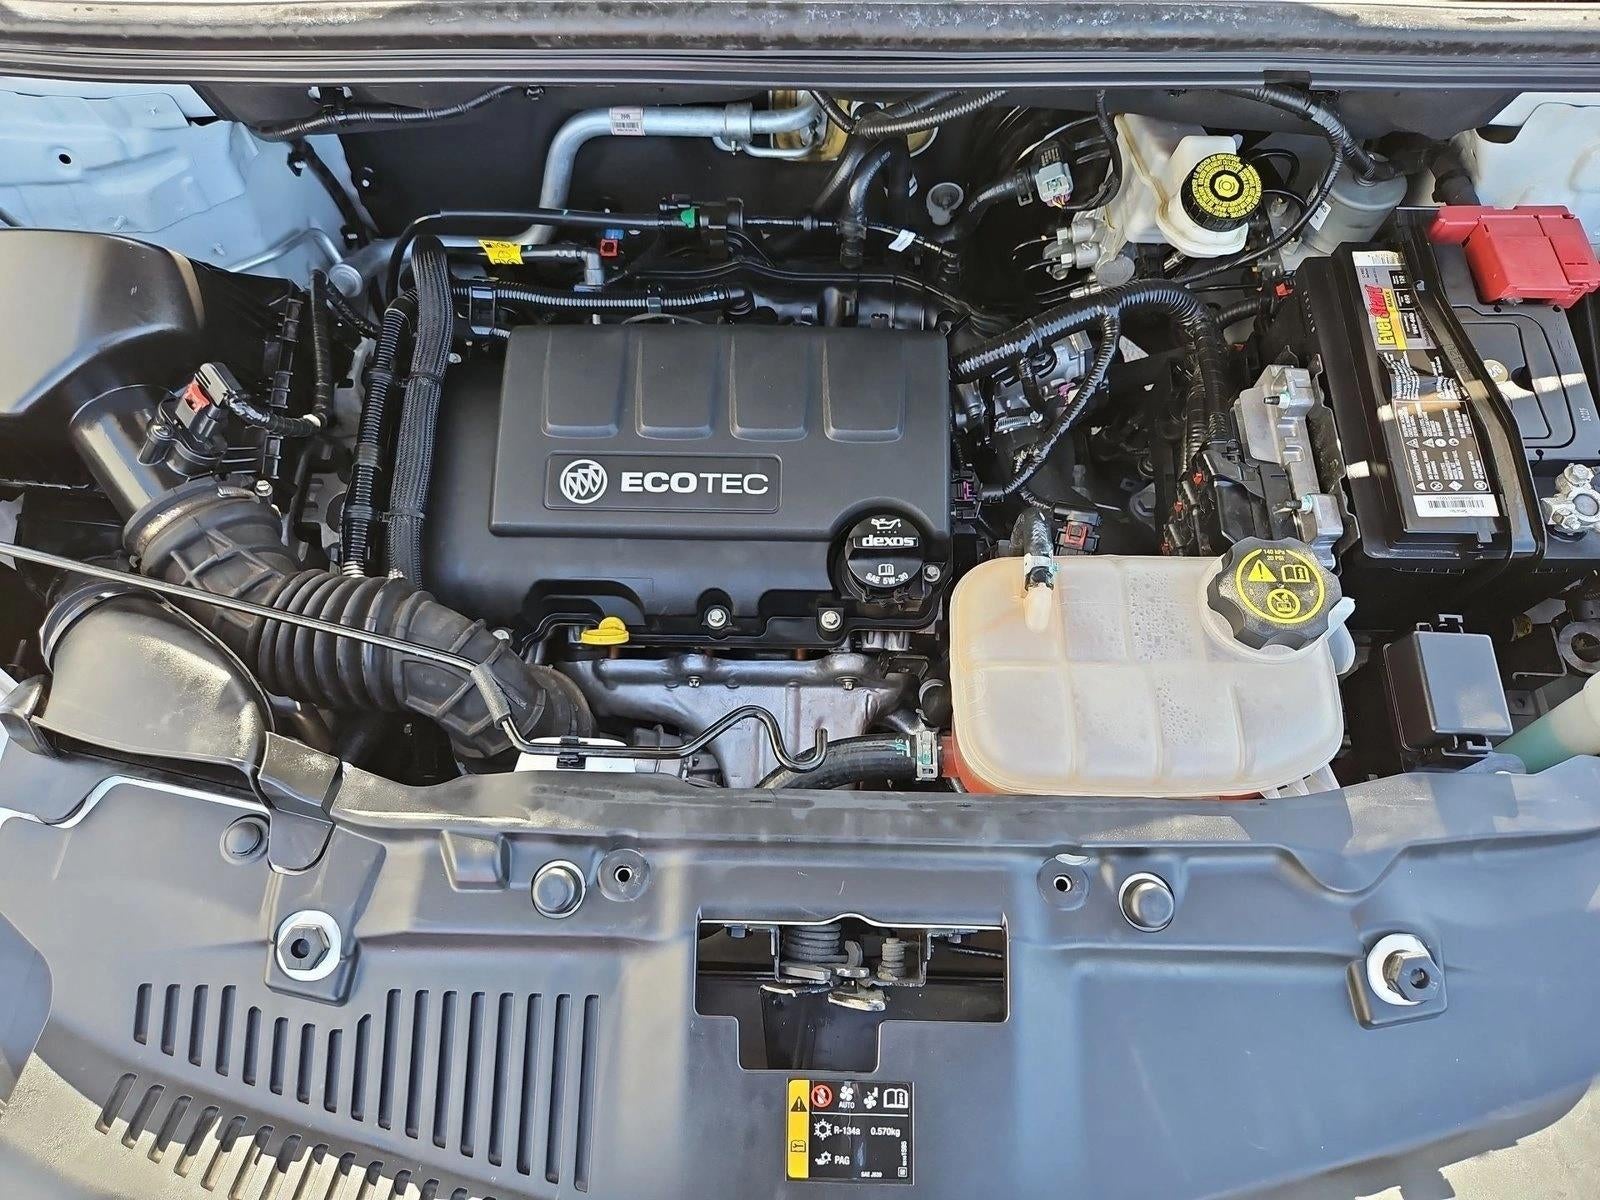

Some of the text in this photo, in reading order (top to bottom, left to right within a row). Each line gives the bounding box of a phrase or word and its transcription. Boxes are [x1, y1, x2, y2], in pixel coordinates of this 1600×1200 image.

[620, 471, 769, 495] ECOTEC
[862, 534, 915, 547] dexos
[865, 572, 909, 585] SAE 5W-30
[838, 1101, 855, 1109] AUTO
[833, 1125, 901, 1137] R-134a 0.570kg
[834, 1155, 850, 1165] PAG
